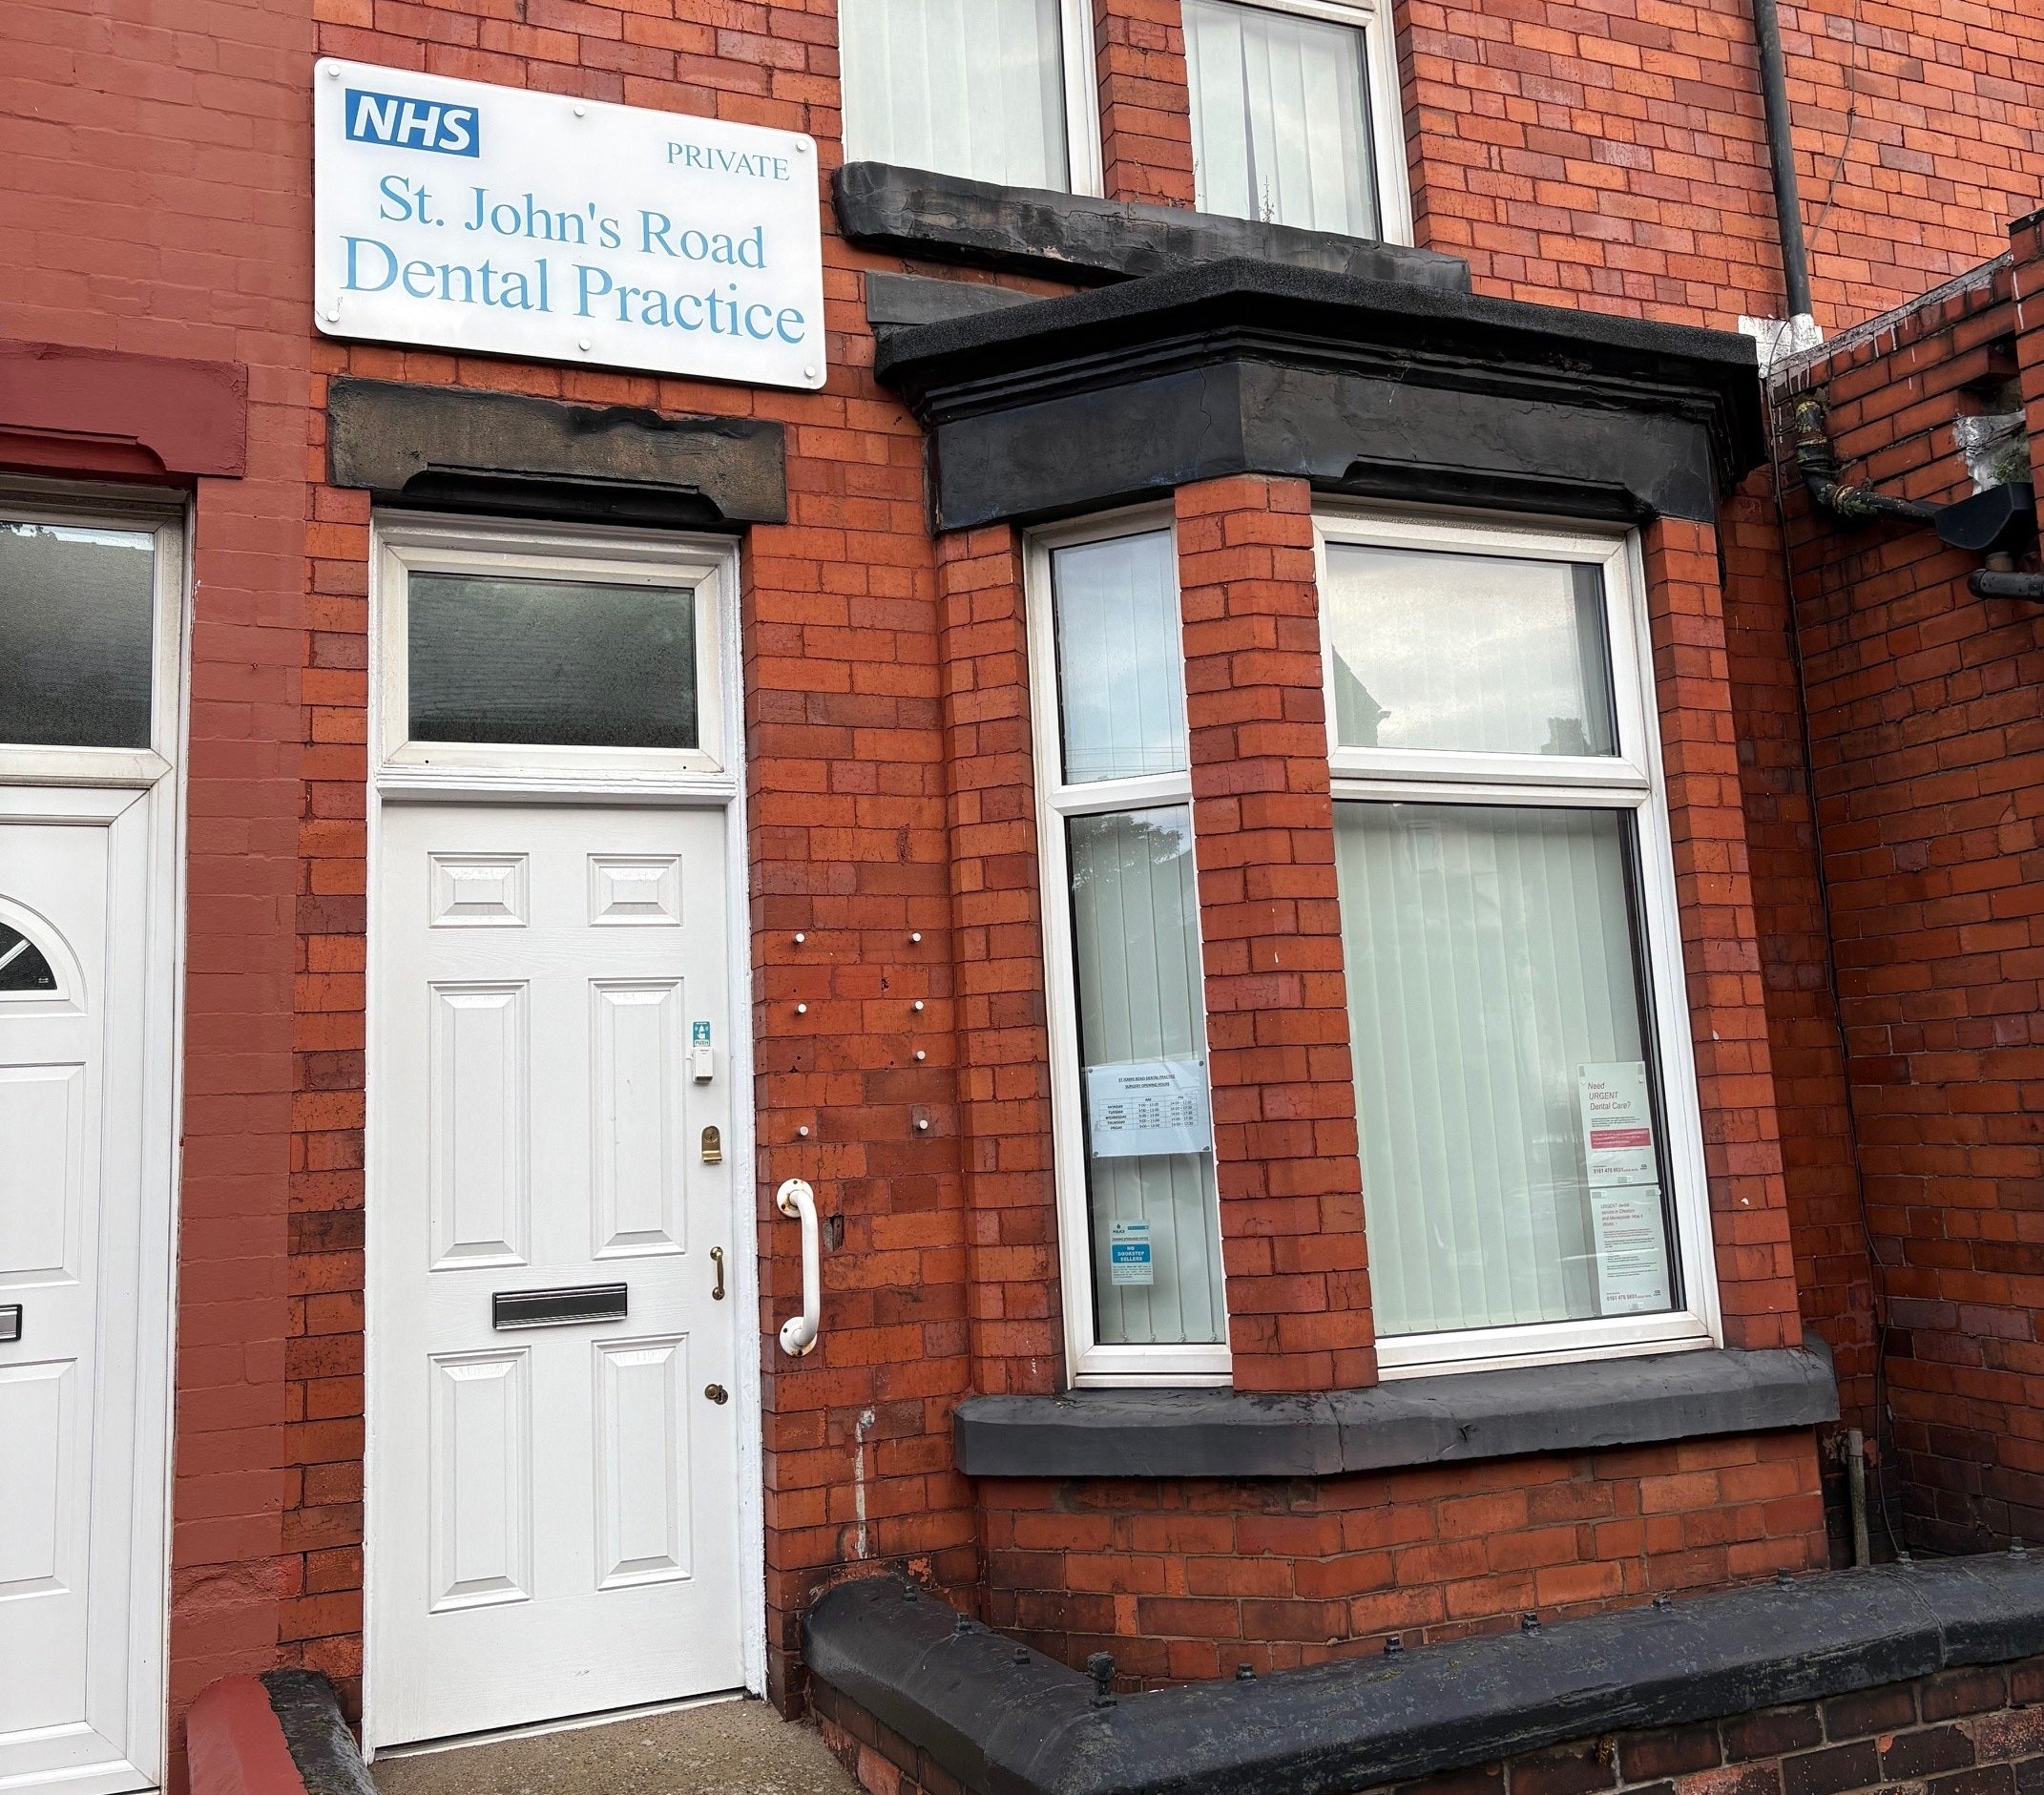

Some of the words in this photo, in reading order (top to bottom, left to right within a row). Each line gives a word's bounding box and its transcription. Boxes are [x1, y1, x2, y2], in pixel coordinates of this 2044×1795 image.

[352, 95, 472, 151] NHS
[667, 142, 790, 180] PRIVATE
[380, 175, 444, 226] St.
[465, 186, 620, 249] John's
[637, 210, 767, 269] Road
[339, 236, 553, 312] Dental
[572, 263, 805, 344] Practice
[1589, 1091, 1618, 1100] URGENT
[1590, 1102, 1611, 1111] Dental
[1612, 1101, 1632, 1110] Care?
